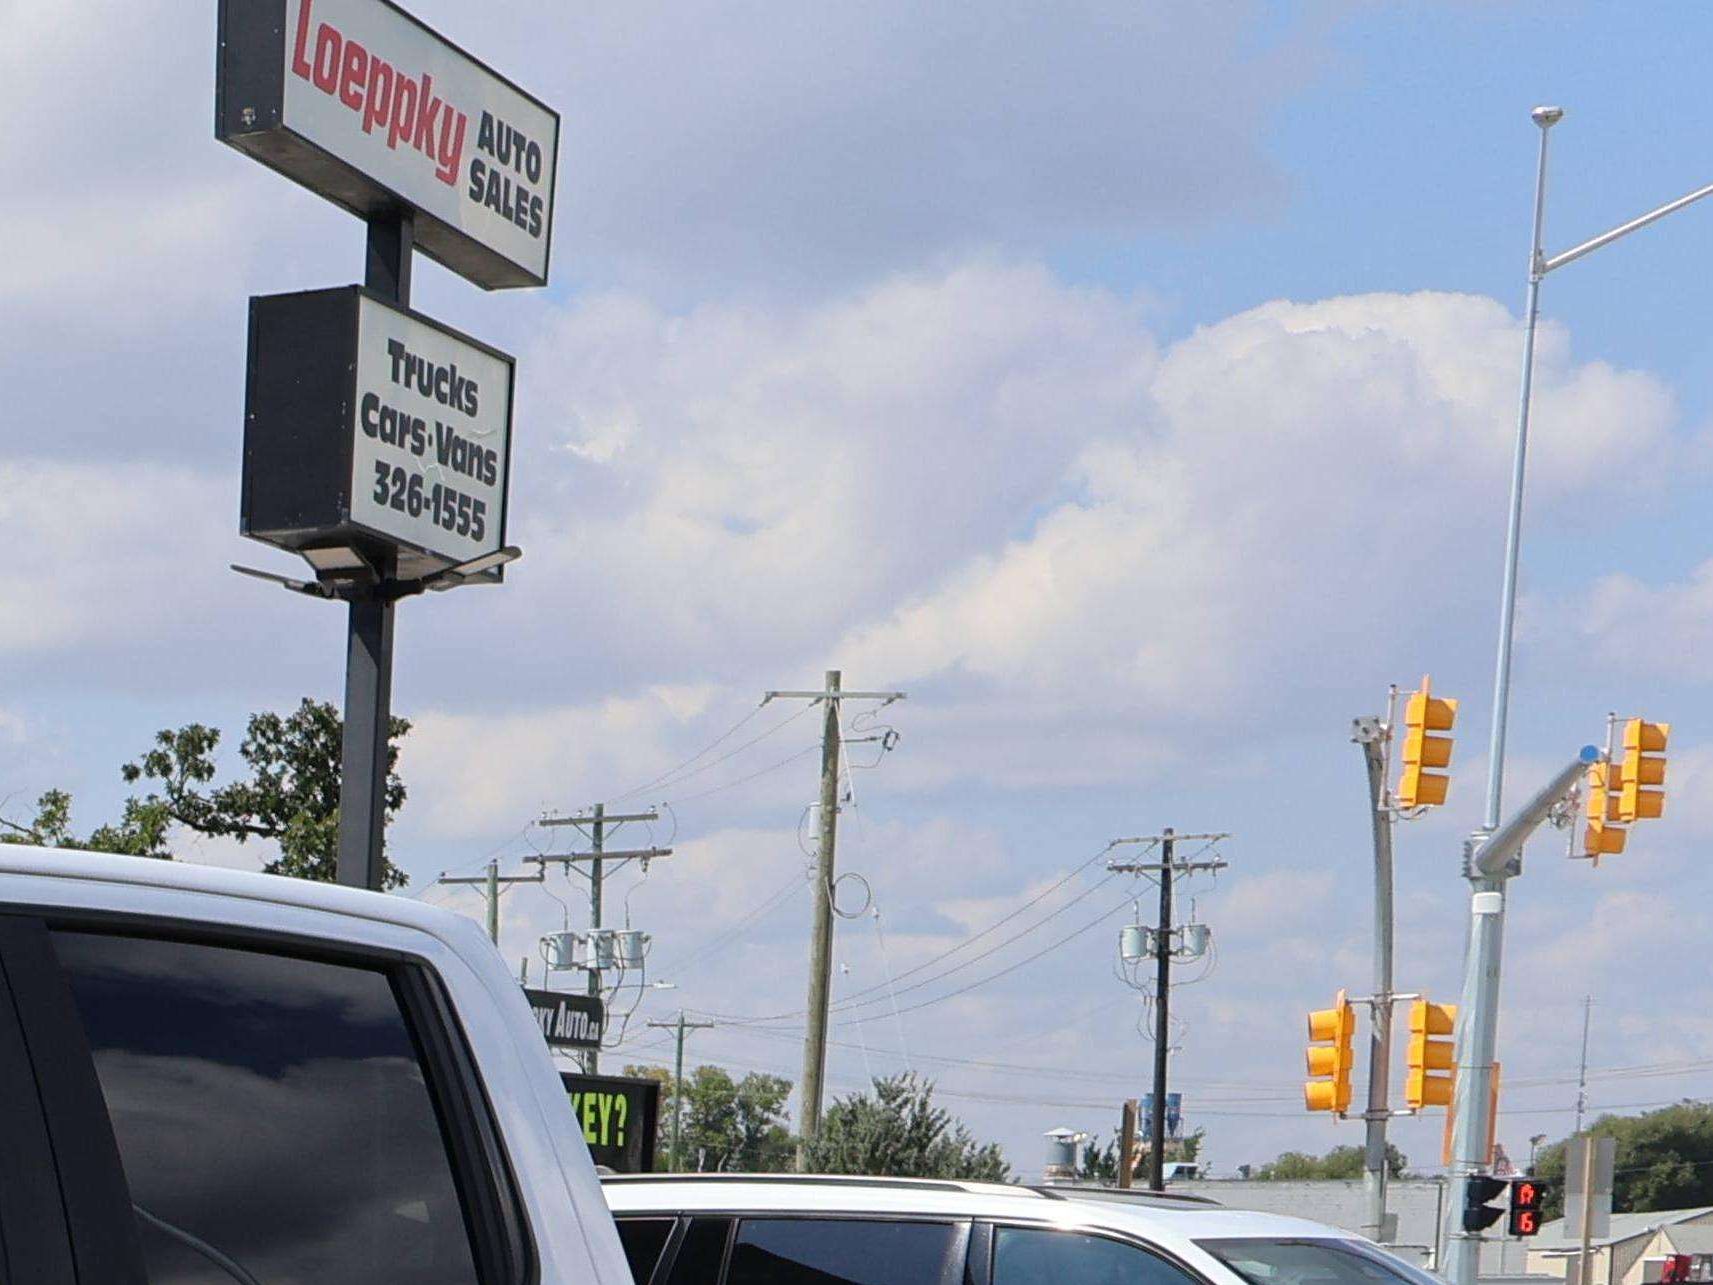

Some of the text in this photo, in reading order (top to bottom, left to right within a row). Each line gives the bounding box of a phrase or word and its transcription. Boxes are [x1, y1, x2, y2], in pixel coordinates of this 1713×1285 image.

[291, 0, 466, 186] Loeppky
[476, 110, 541, 183] AUTO
[469, 157, 542, 239] SALES
[388, 338, 479, 418] Trucks
[373, 461, 486, 541] 326-1555
